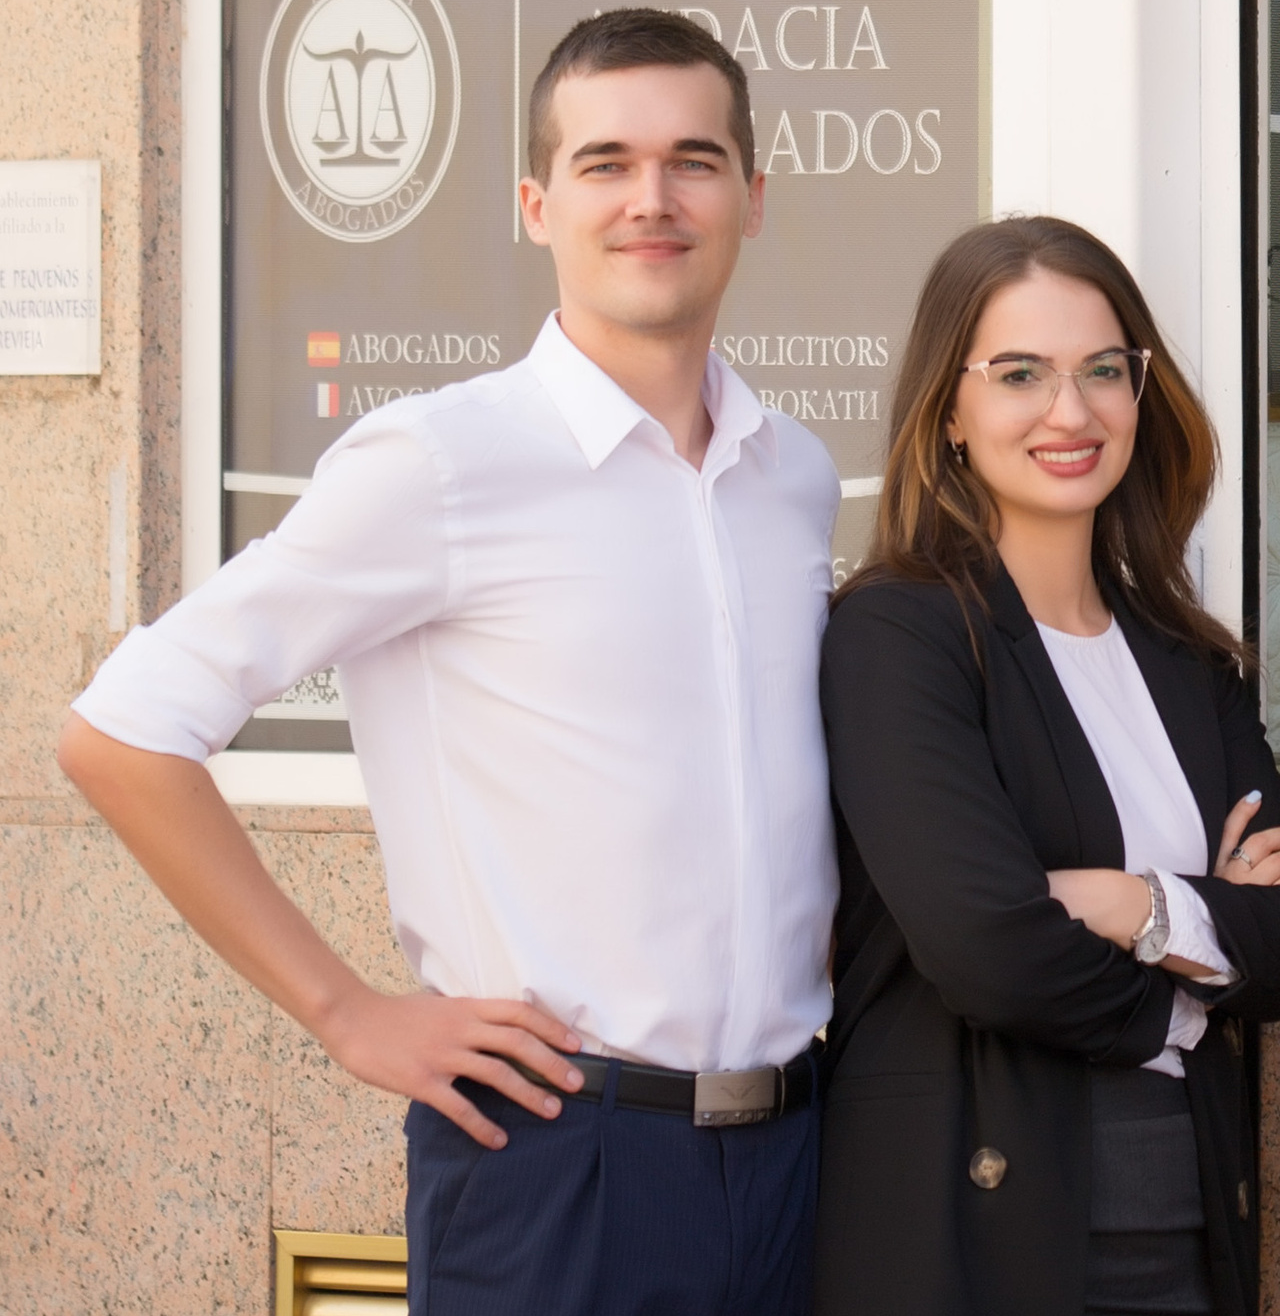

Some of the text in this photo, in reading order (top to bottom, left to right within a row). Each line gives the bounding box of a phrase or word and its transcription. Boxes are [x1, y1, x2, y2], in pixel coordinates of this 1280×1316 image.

[750, 108, 943, 175] ADOS
[293, 172, 426, 231] ABOGADOS
[0, 217, 41, 234] filiado
[345, 333, 889, 367] ABOGADOS SOLICITORS
[758, 389, 880, 421] ВОКАТИ
